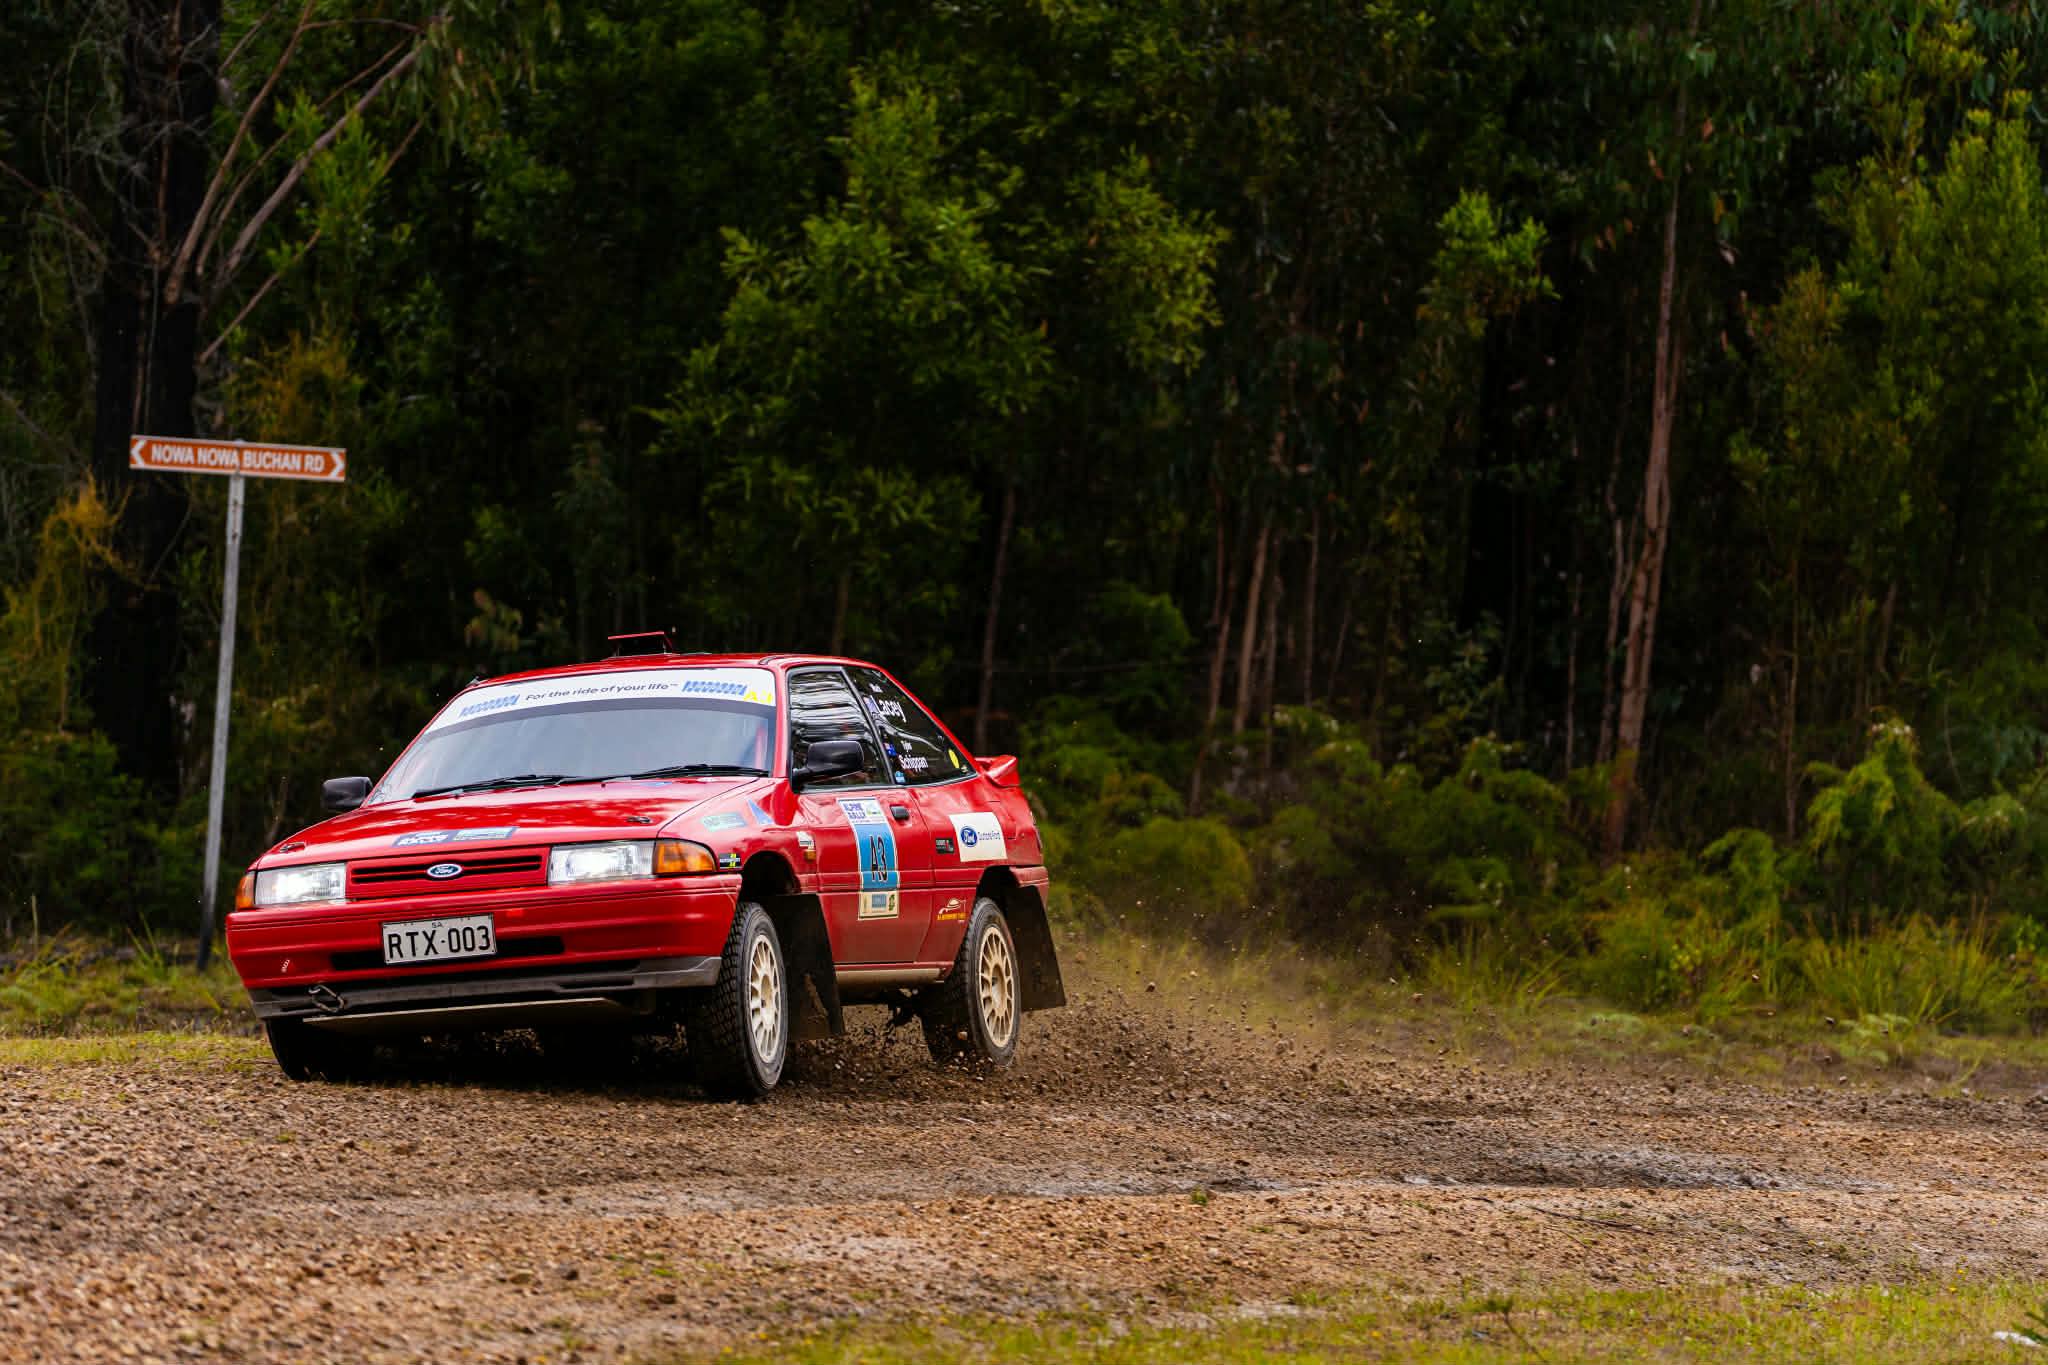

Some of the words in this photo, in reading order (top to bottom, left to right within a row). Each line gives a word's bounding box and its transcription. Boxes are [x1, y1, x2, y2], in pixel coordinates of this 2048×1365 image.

[151, 443, 194, 465] NOWA
[198, 447, 241, 468] NOWA
[242, 451, 301, 472] BUCHAN
[303, 454, 326, 474] RD
[525, 693, 546, 701] For
[549, 690, 570, 698] the
[572, 687, 598, 696] ride
[600, 685, 616, 693] of
[616, 684, 646, 693] your
[869, 835, 888, 882] A3
